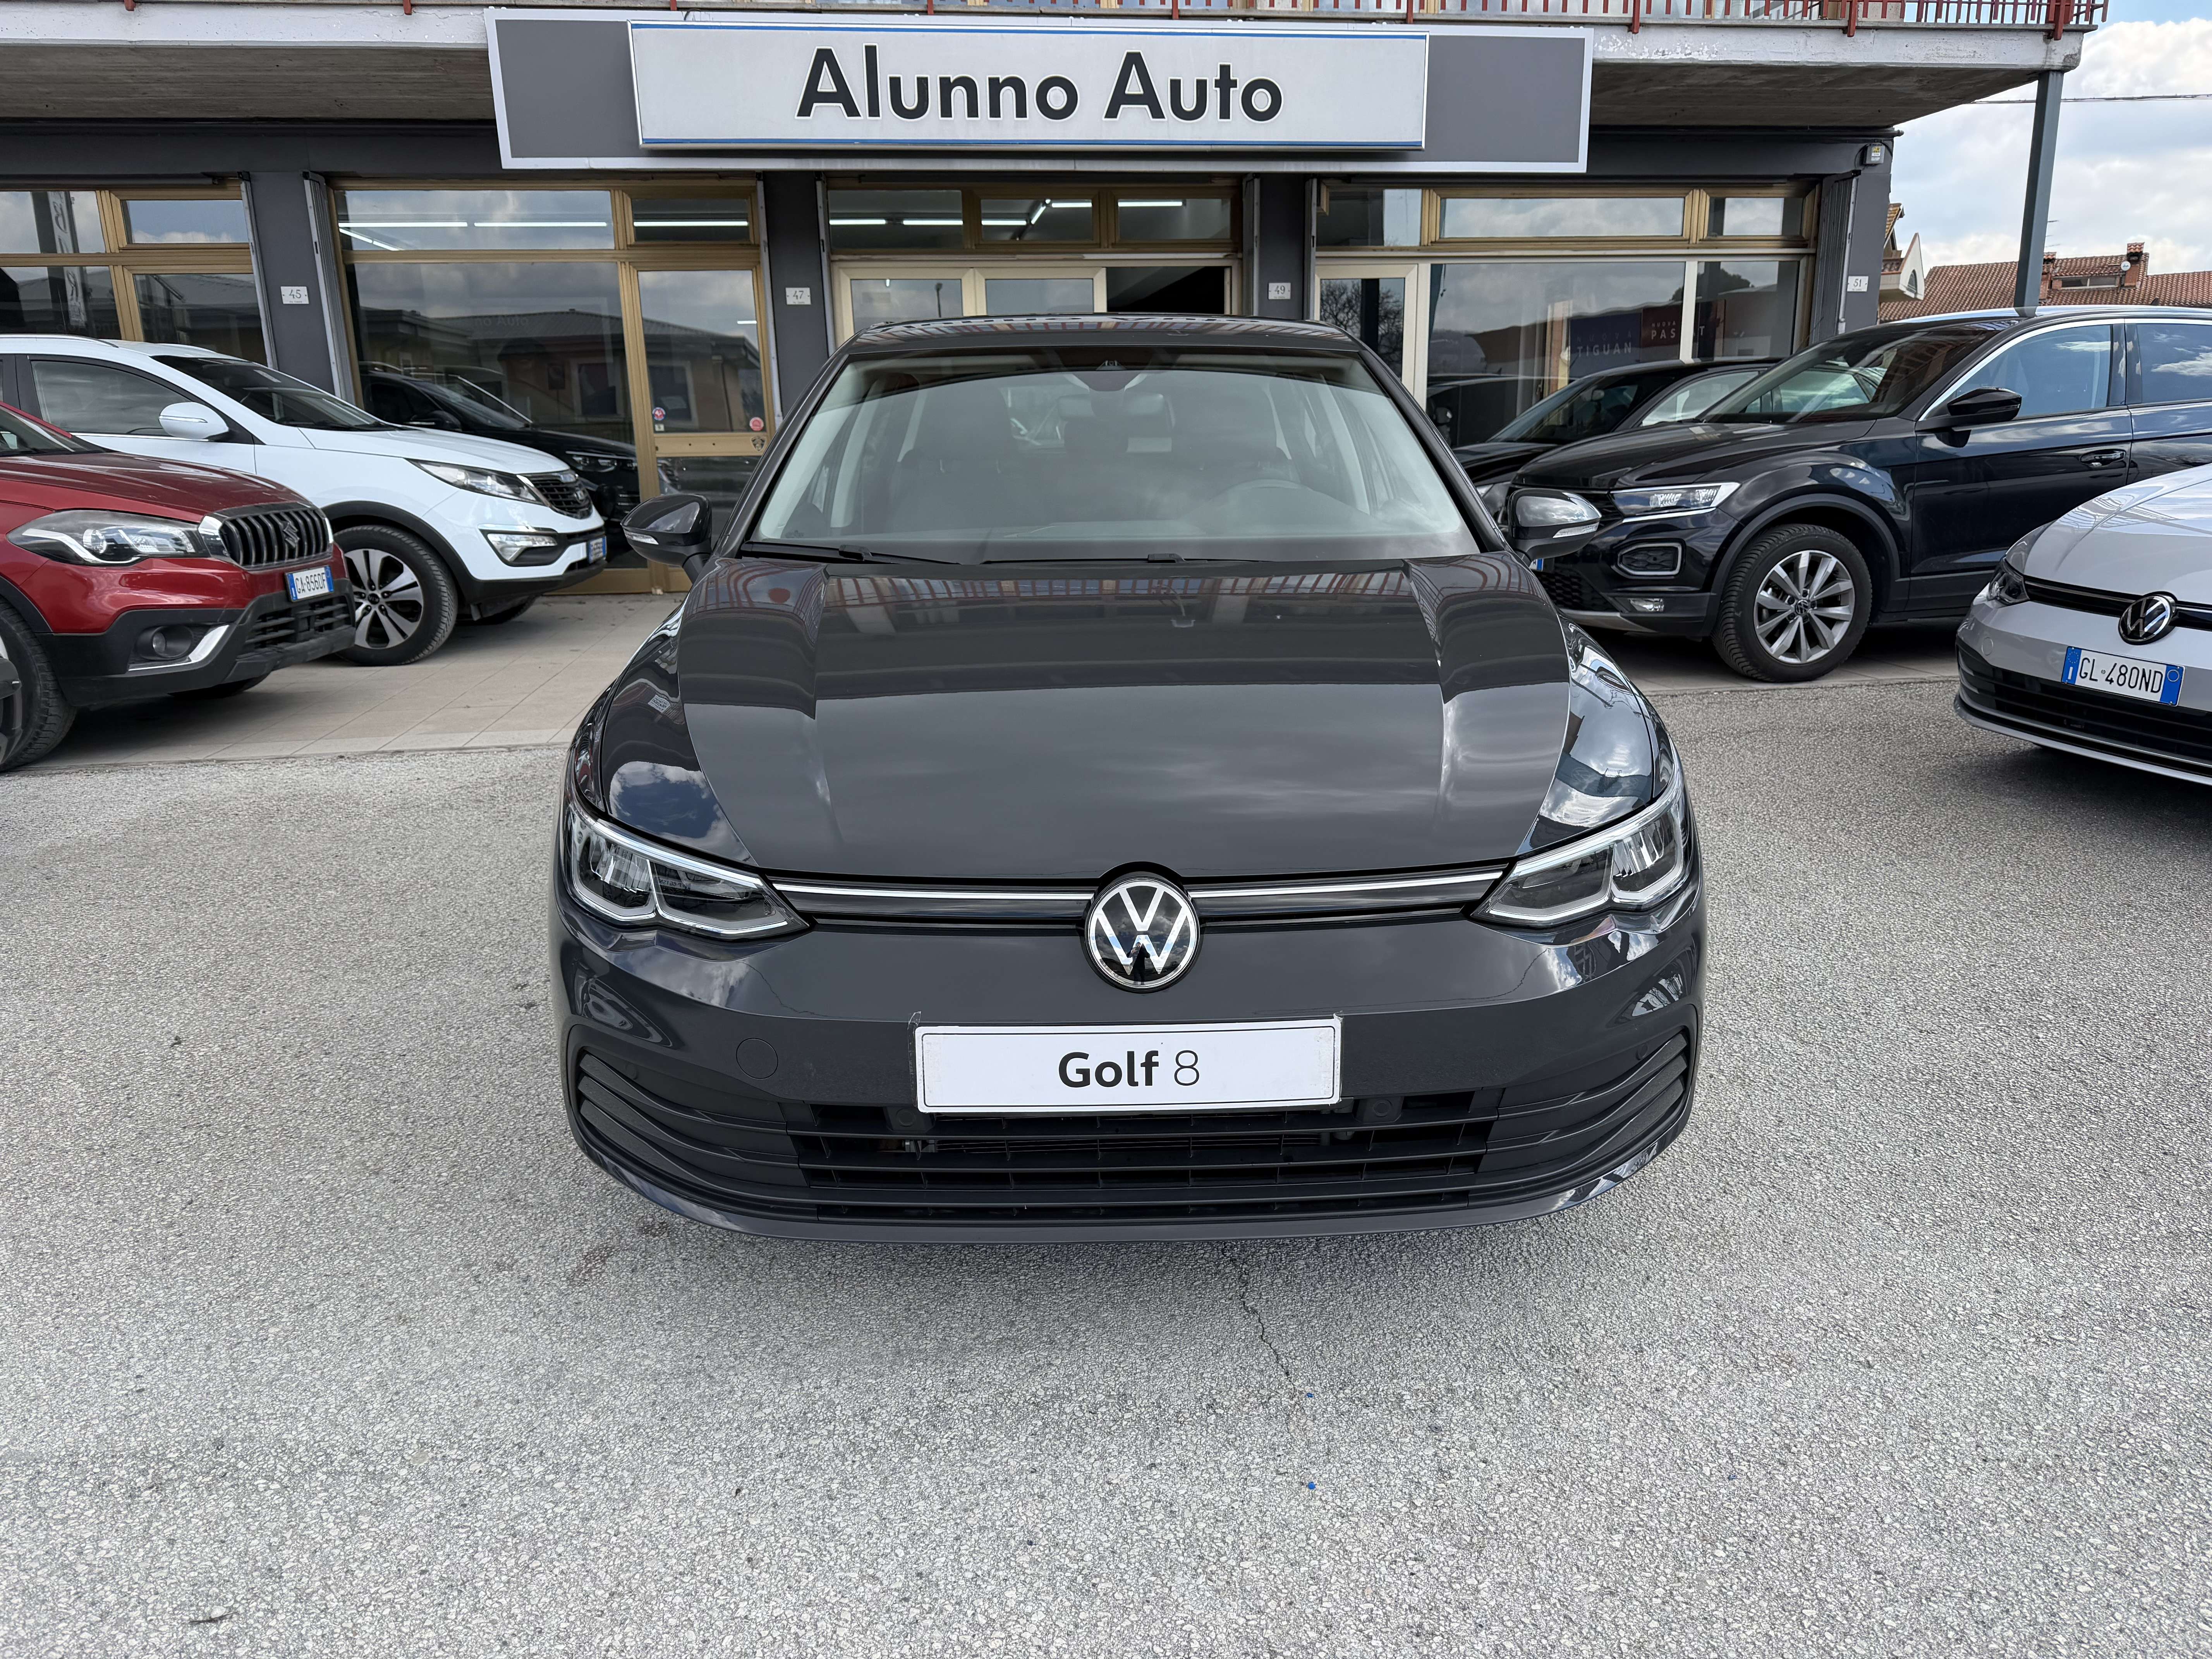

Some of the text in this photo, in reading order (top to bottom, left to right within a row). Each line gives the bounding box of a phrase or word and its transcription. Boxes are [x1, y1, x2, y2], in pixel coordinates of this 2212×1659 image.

[797, 46, 1281, 121] Alunno Auto
[1274, 285, 1285, 295] 49
[1853, 278, 1862, 287] 51
[289, 289, 301, 299] 45
[793, 290, 804, 300] 47
[1577, 342, 1632, 357] TIGUAN
[295, 577, 305, 594] GA
[306, 573, 326, 592] 856DF
[2079, 657, 2098, 682] GL
[2105, 663, 2164, 693] 480ND
[1059, 1050, 1199, 1087] Golf 8
